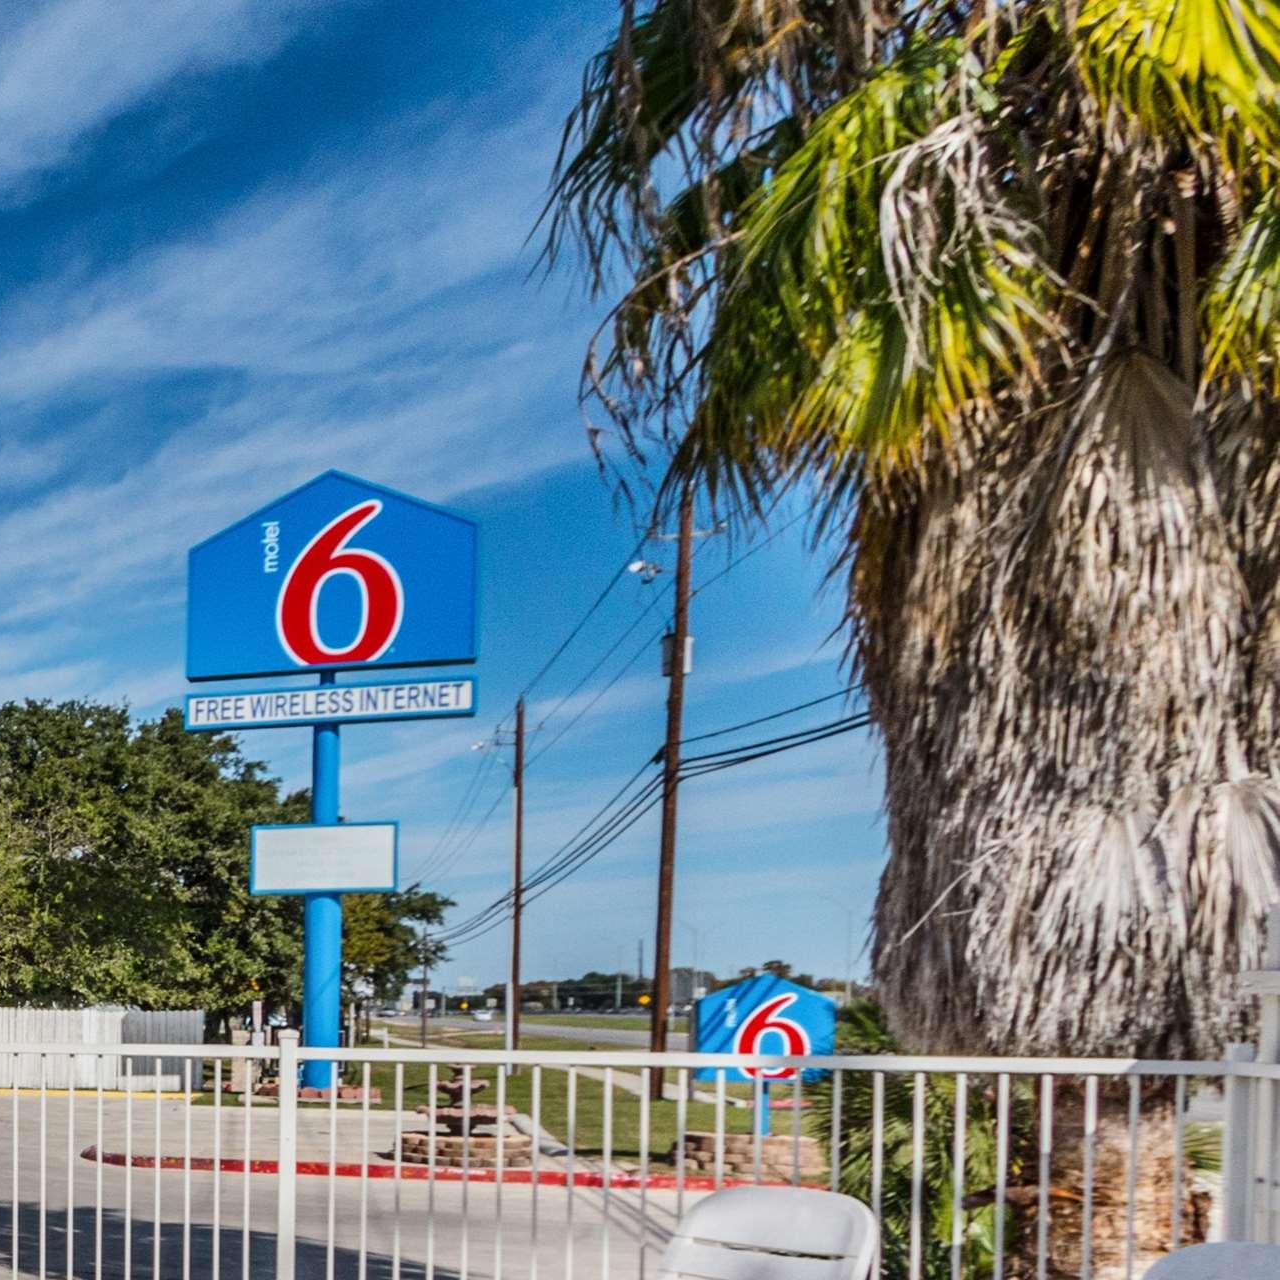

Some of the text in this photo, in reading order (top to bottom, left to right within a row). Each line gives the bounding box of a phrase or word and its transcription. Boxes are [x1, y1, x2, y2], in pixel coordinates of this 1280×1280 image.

[260, 499, 405, 667] motel 6
[195, 682, 465, 722] FREE WIRELESS INTERNET
[733, 992, 811, 1080] 6
